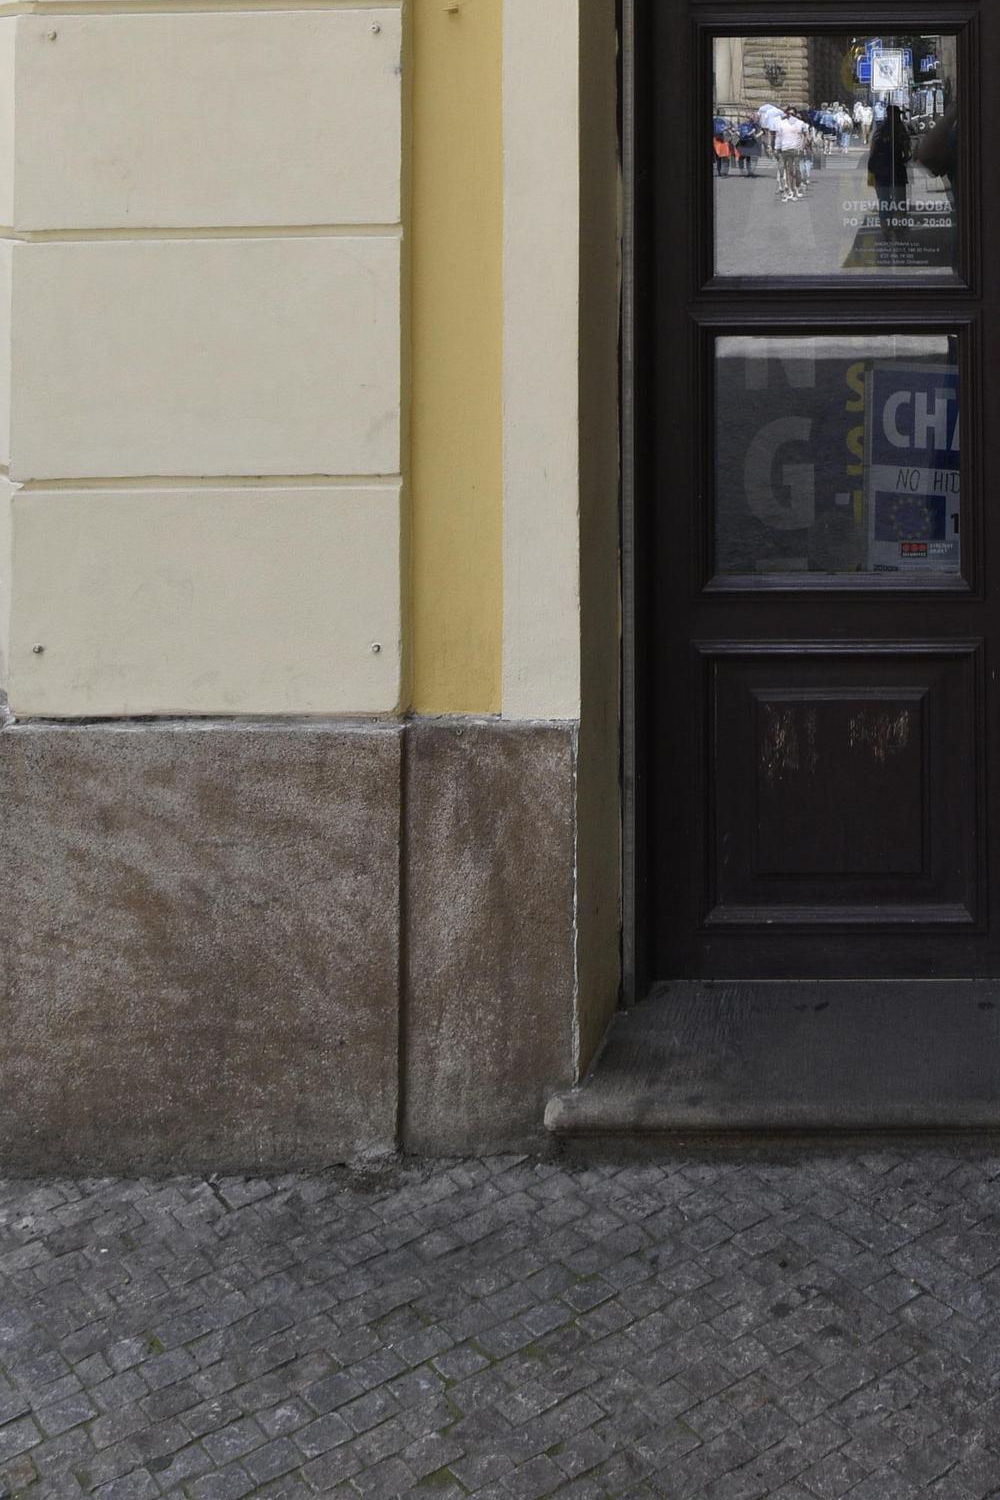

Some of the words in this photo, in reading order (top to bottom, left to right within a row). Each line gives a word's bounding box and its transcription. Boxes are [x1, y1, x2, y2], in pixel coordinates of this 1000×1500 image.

[915, 200, 953, 212] DOBA
[843, 218, 858, 227] PO
[866, 218, 881, 227] NE
[886, 218, 914, 227] 10:00
[923, 218, 952, 227] 20:00
[883, 390, 960, 451] CH
[896, 468, 922, 493] NO
